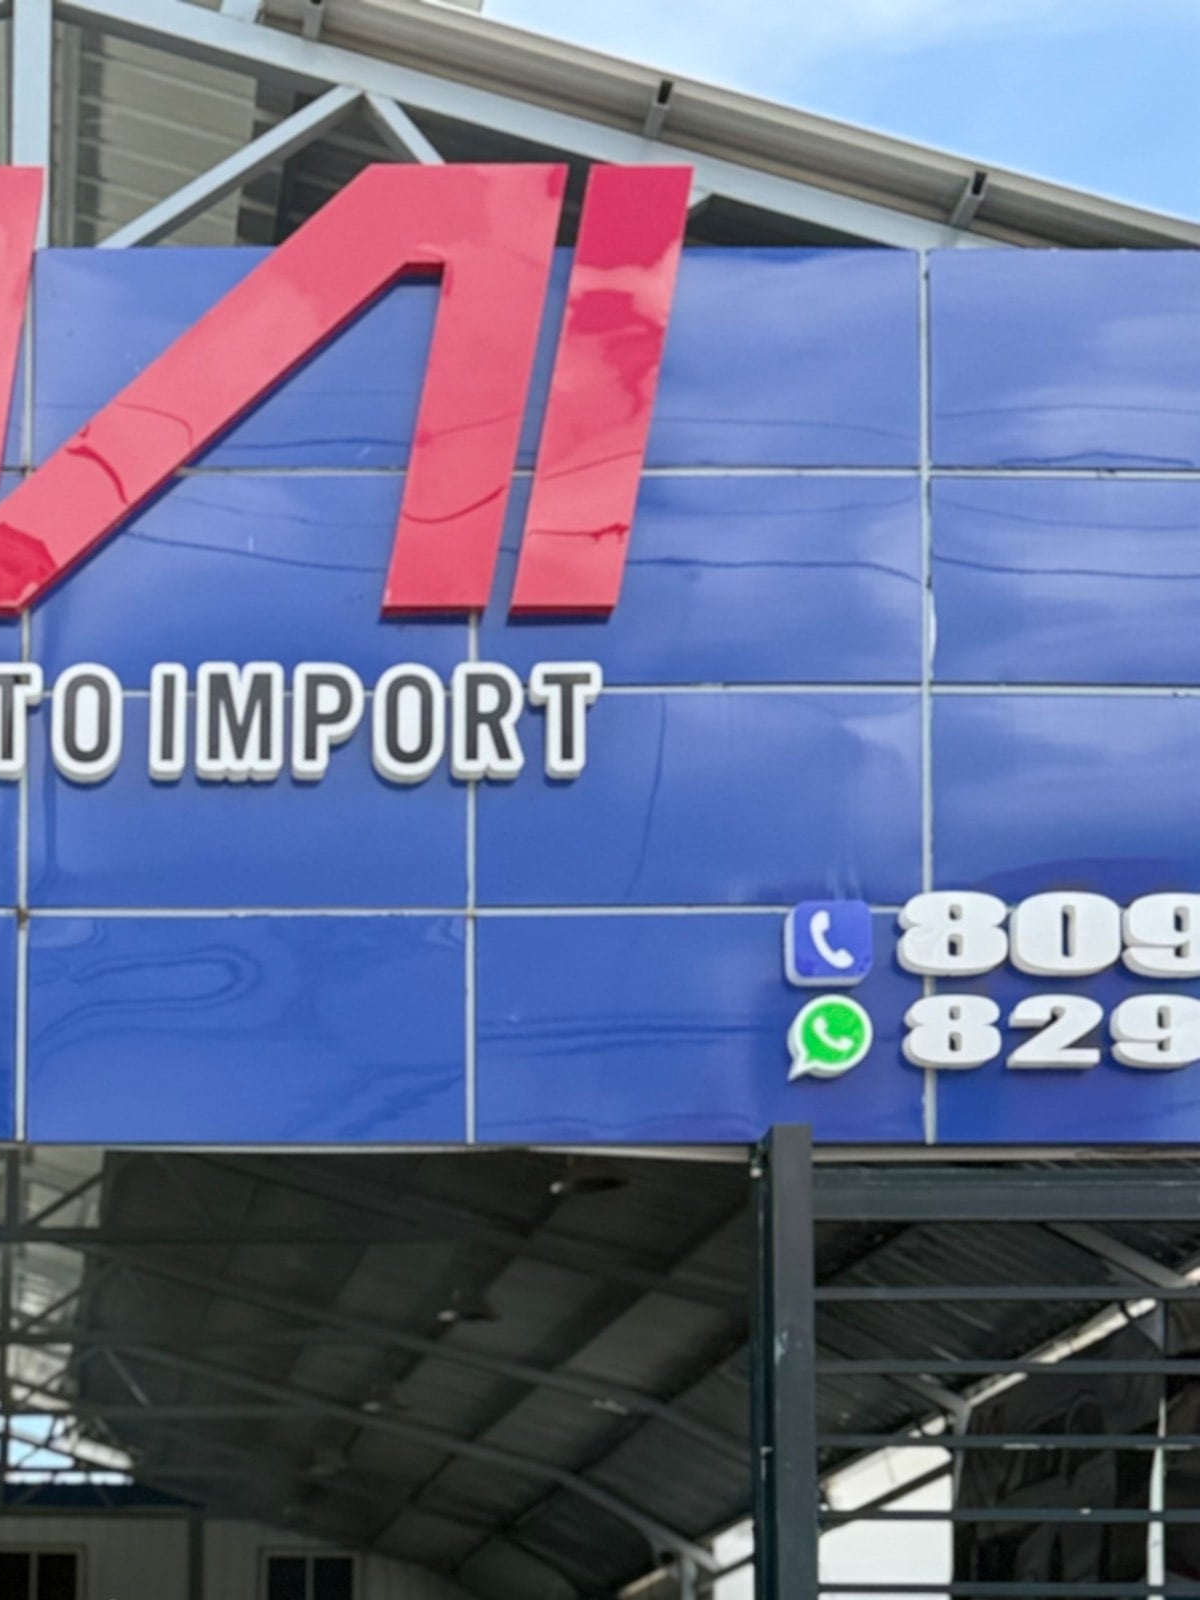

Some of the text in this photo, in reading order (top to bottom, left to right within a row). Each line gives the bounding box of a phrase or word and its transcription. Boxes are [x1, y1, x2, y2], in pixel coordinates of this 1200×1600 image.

[149, 662, 603, 782] IMPORT
[897, 891, 1200, 978] 809
[903, 994, 1200, 1069] 829
